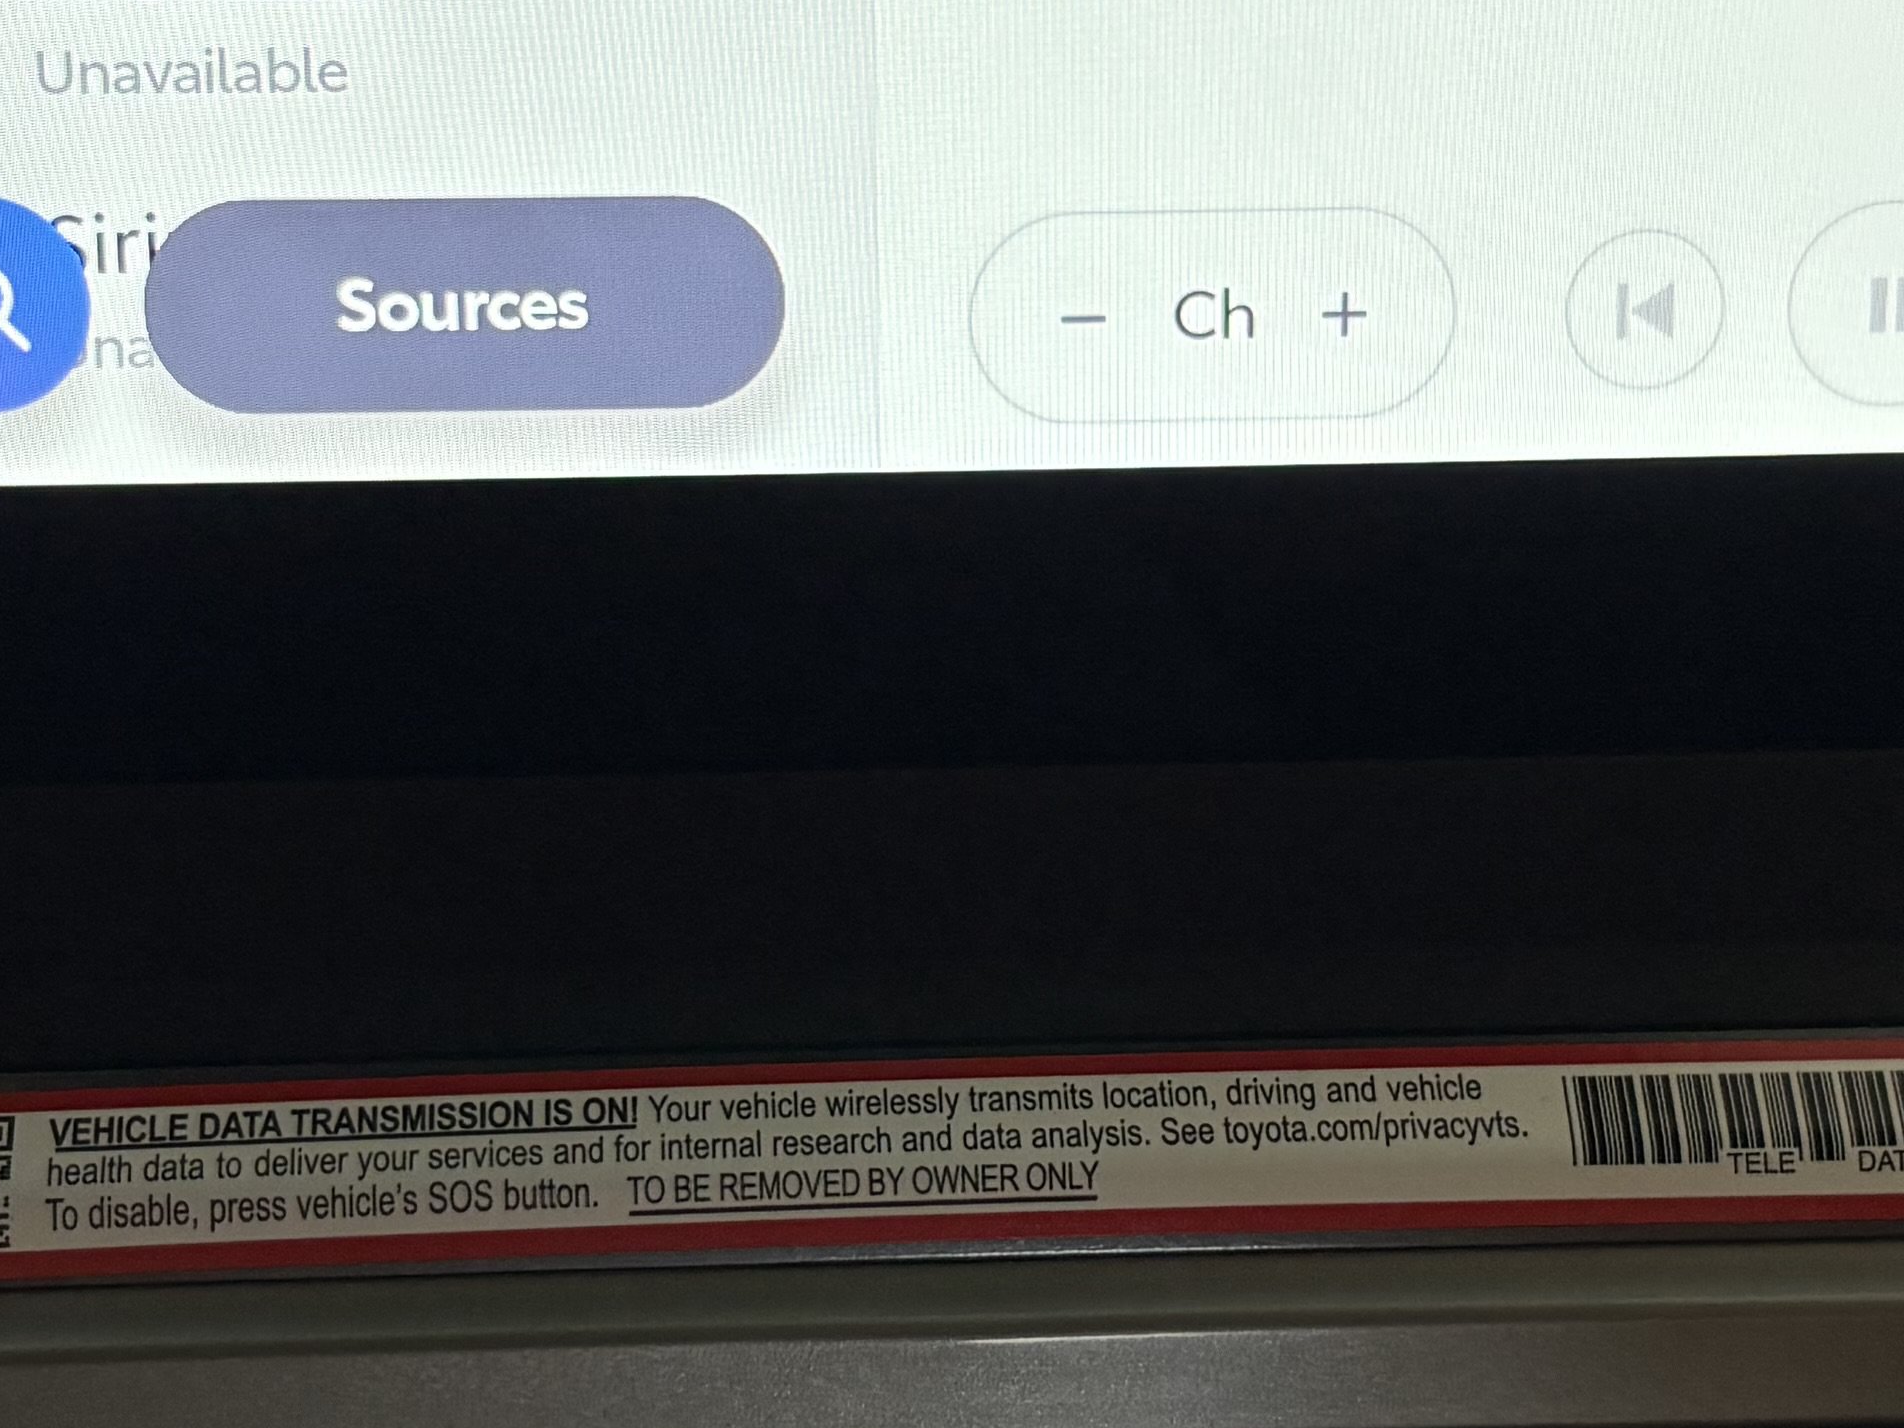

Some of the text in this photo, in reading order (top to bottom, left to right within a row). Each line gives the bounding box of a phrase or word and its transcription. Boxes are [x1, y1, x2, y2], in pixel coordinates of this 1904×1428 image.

[35, 45, 350, 99] Unavailable
[336, 277, 590, 335] Sources
[1173, 289, 1255, 342] Ch
[50, 1073, 1482, 1147] VEHICLE DATA TRANSMISSION IS ON! Your vehicle wirelessly transmits location, driving and vehicle
[48, 1110, 1529, 1187] health data to deliver your services and for internal research and data analysis. See toyota.com/privacyvts.
[1727, 1150, 1796, 1176] TELE
[47, 1176, 598, 1233] To disable, press vehicle's SOS button.
[627, 1160, 1099, 1207] TO BE REMOVED BY OWNER ONLY
